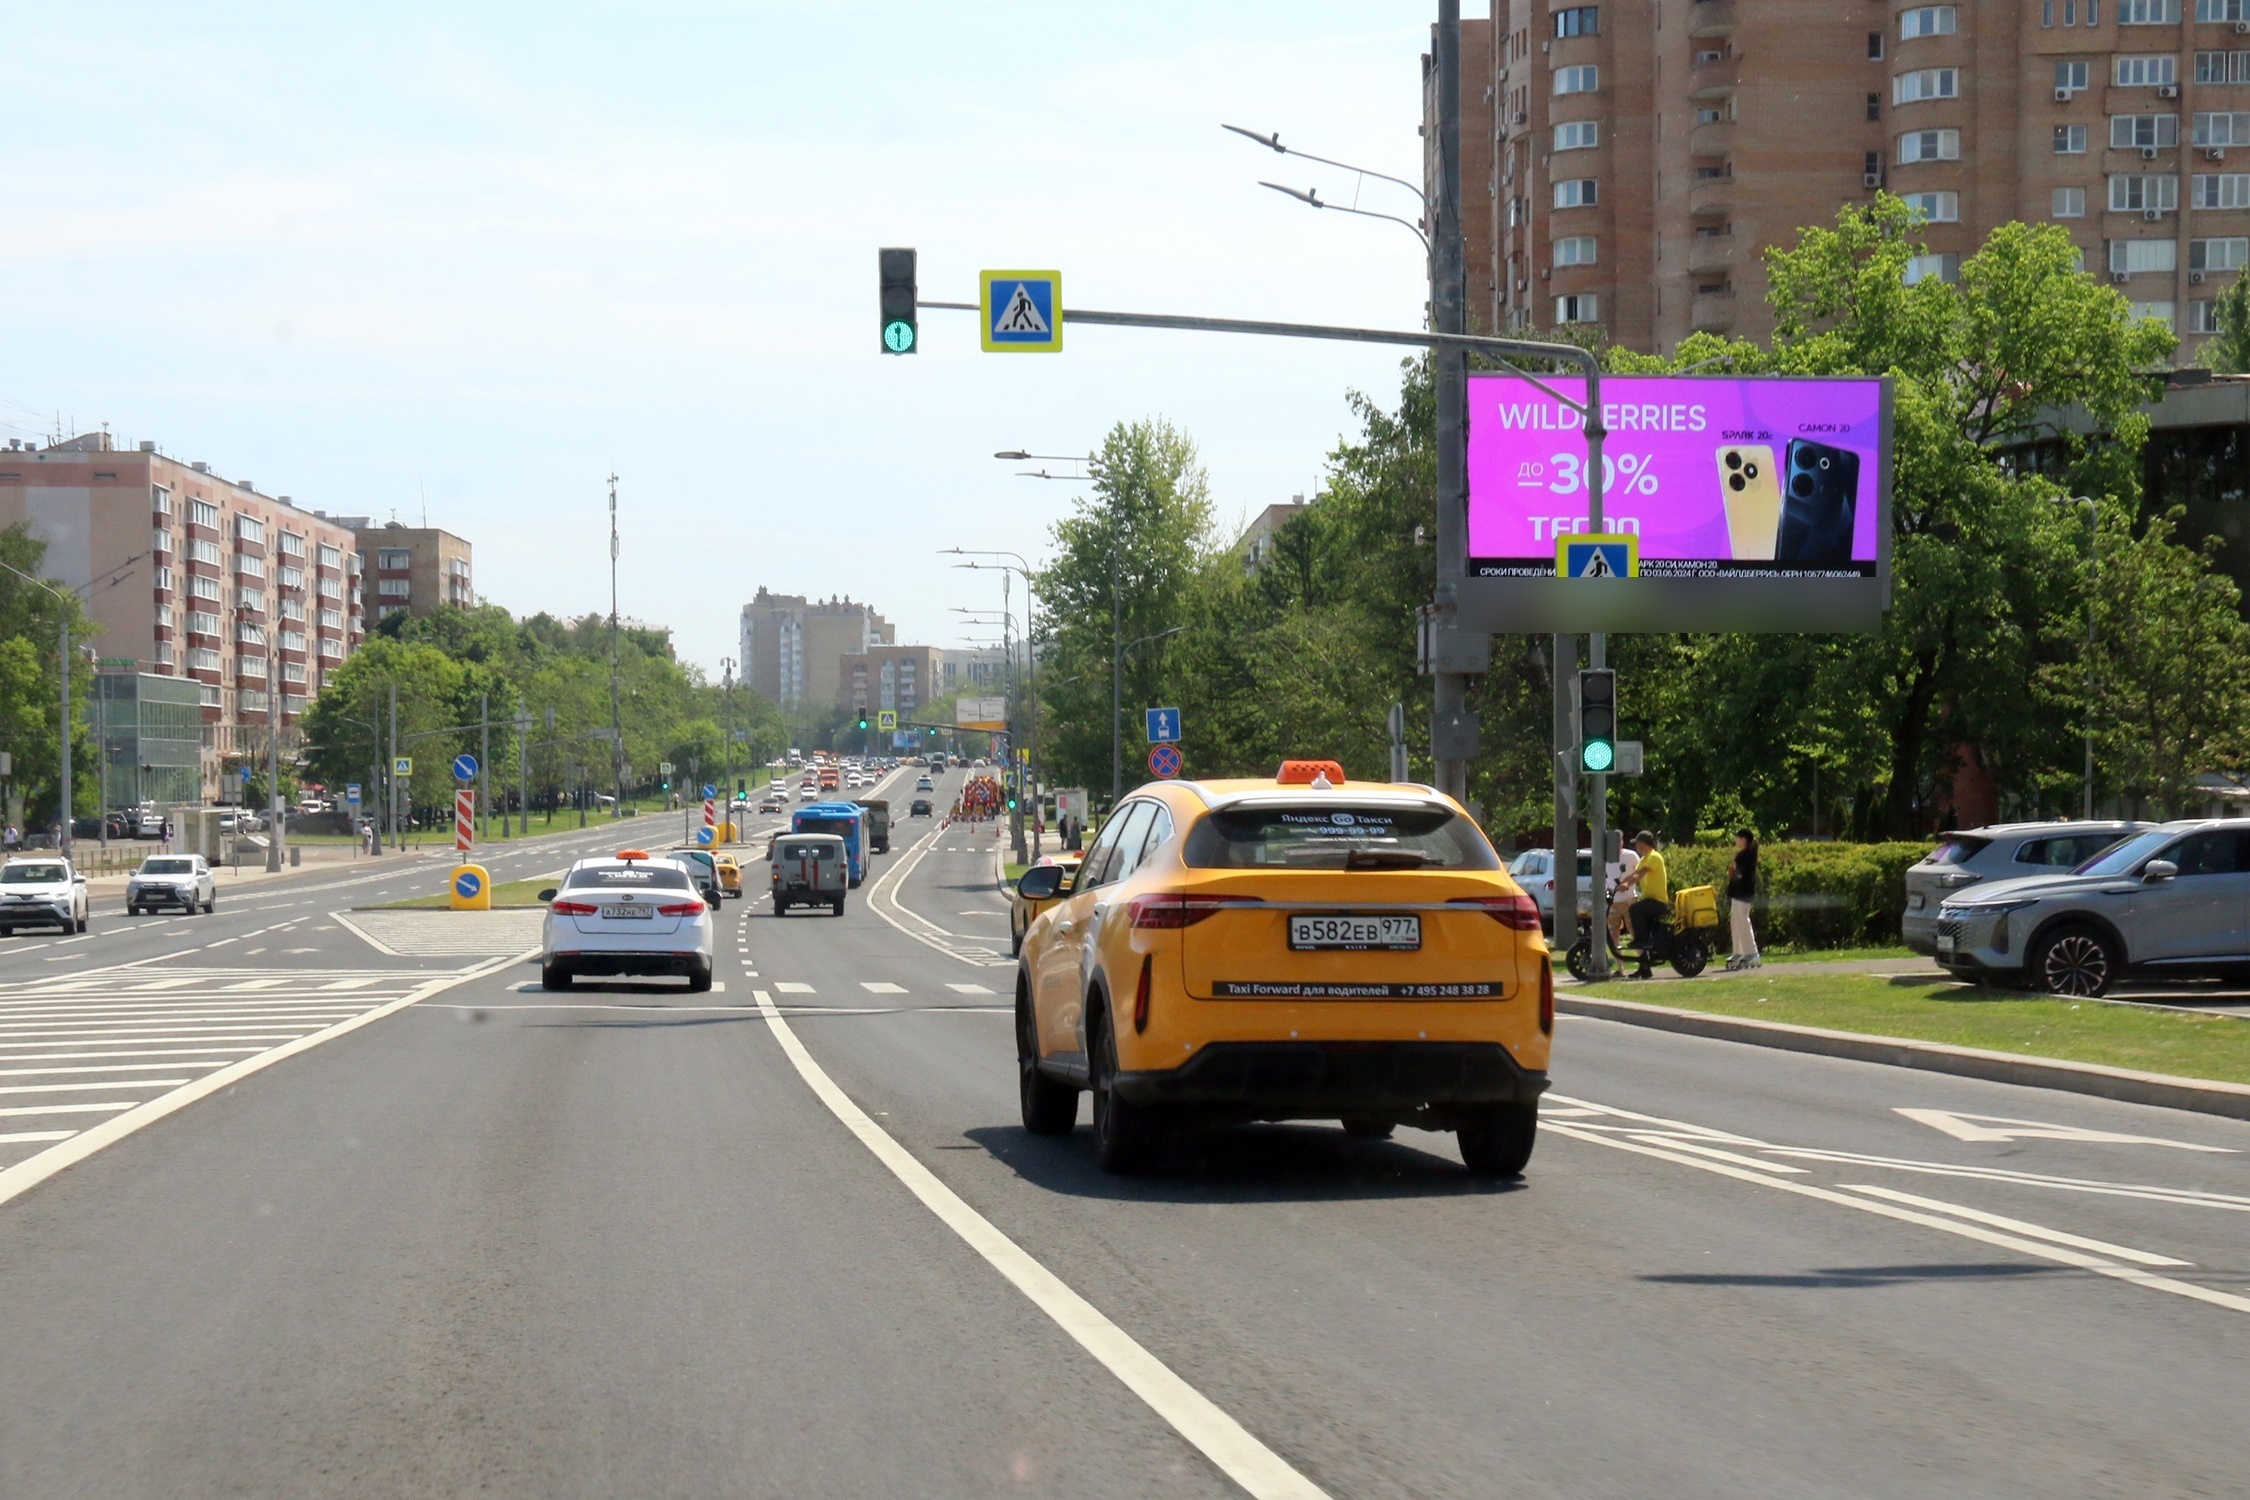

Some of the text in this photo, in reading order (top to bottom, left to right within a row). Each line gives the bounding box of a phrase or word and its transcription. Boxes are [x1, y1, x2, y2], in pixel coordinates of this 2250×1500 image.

[1499, 403, 1707, 431] WILDERRIES
[1798, 423, 1850, 433] CAMON 20
[1722, 431, 1754, 440] SPARK
[1678, 561, 1708, 569] КАМОН
[1480, 567, 1508, 576] СРОКИ
[1698, 569, 1716, 577] ООО
[1281, 814, 1329, 824] Яндекс
[1354, 815, 1393, 824] Такси
[1320, 827, 1385, 835] 999-99-99
[1382, 919, 1412, 935] 977
[1228, 984, 1490, 996] Taxi Forward для водителей +7 495 248 38 28
